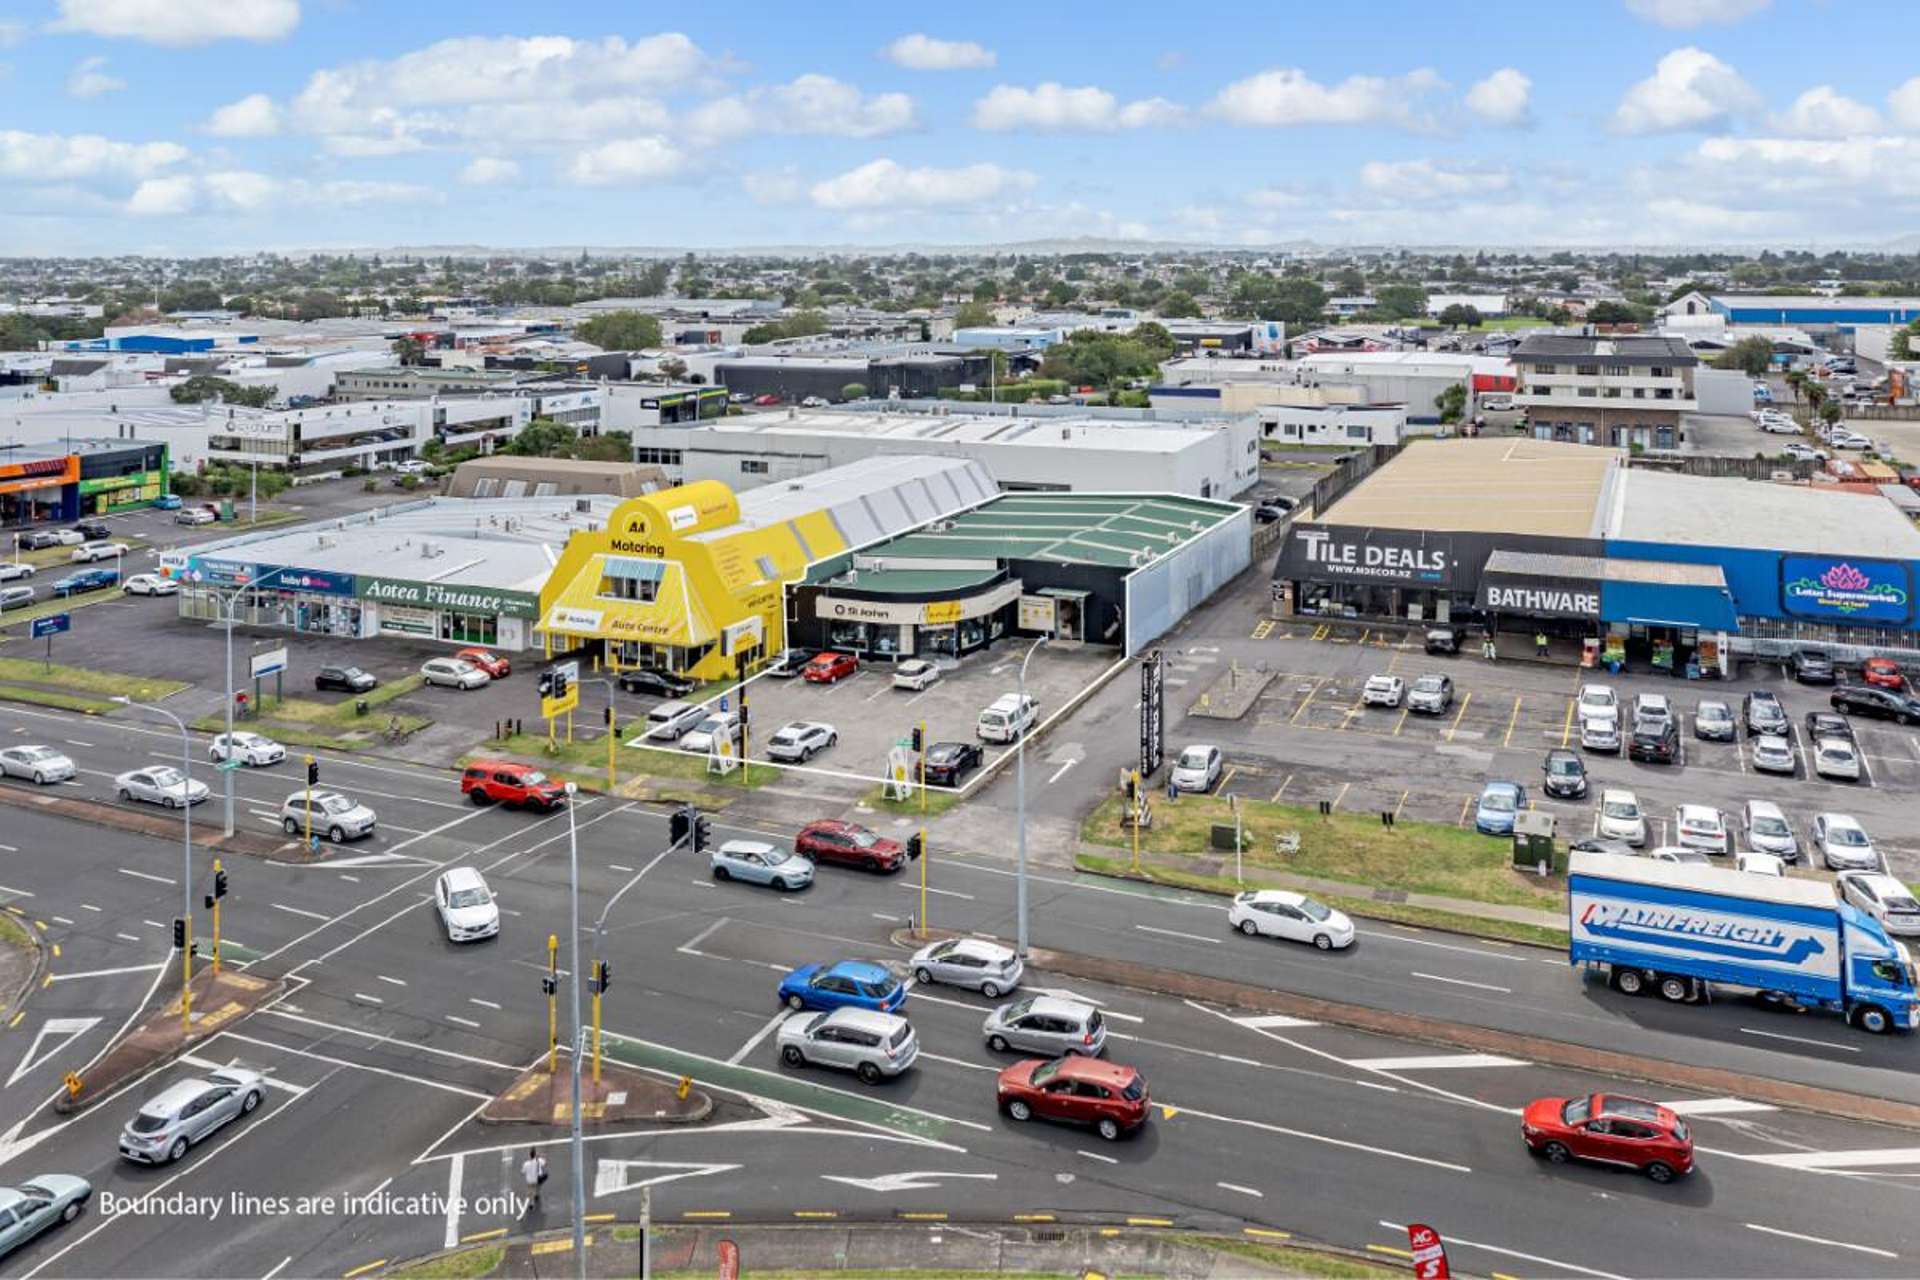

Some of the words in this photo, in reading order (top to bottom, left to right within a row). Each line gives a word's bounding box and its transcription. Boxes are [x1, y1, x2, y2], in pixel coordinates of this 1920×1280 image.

[629, 521, 645, 533] AA
[611, 540, 665, 558] Motoring
[1365, 546, 1445, 571] DEALS
[366, 580, 420, 600] Aotea
[426, 585, 502, 609] Finance
[1487, 586, 1600, 615] BATHWARE
[860, 607, 889, 619] John
[611, 619, 635, 631] Auto
[638, 622, 669, 634] Centre
[1581, 904, 1796, 948] MAINFREIGHT
